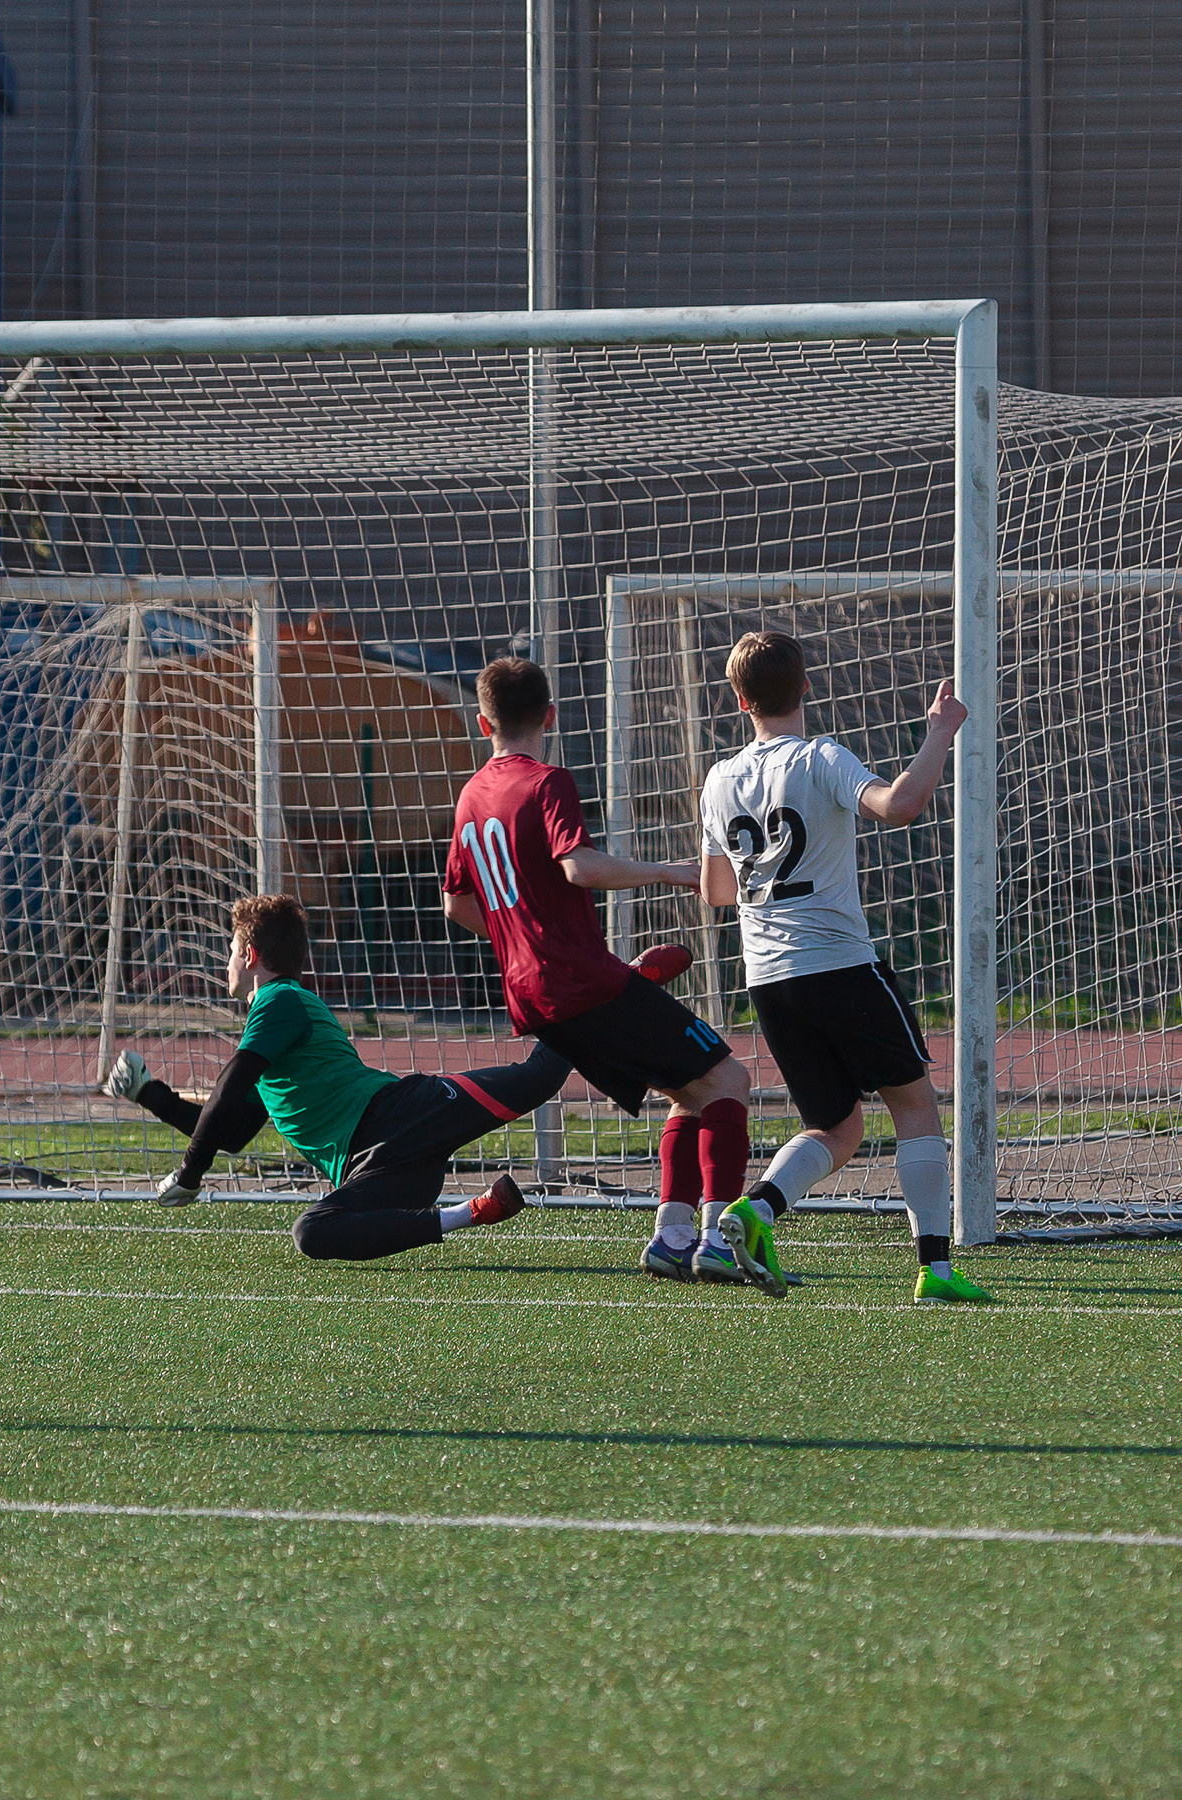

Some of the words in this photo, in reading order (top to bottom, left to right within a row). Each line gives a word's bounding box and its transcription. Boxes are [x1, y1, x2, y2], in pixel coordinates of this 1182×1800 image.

[460, 817, 519, 911] 10
[727, 806, 815, 904] 22
[685, 1019, 719, 1052] 10
